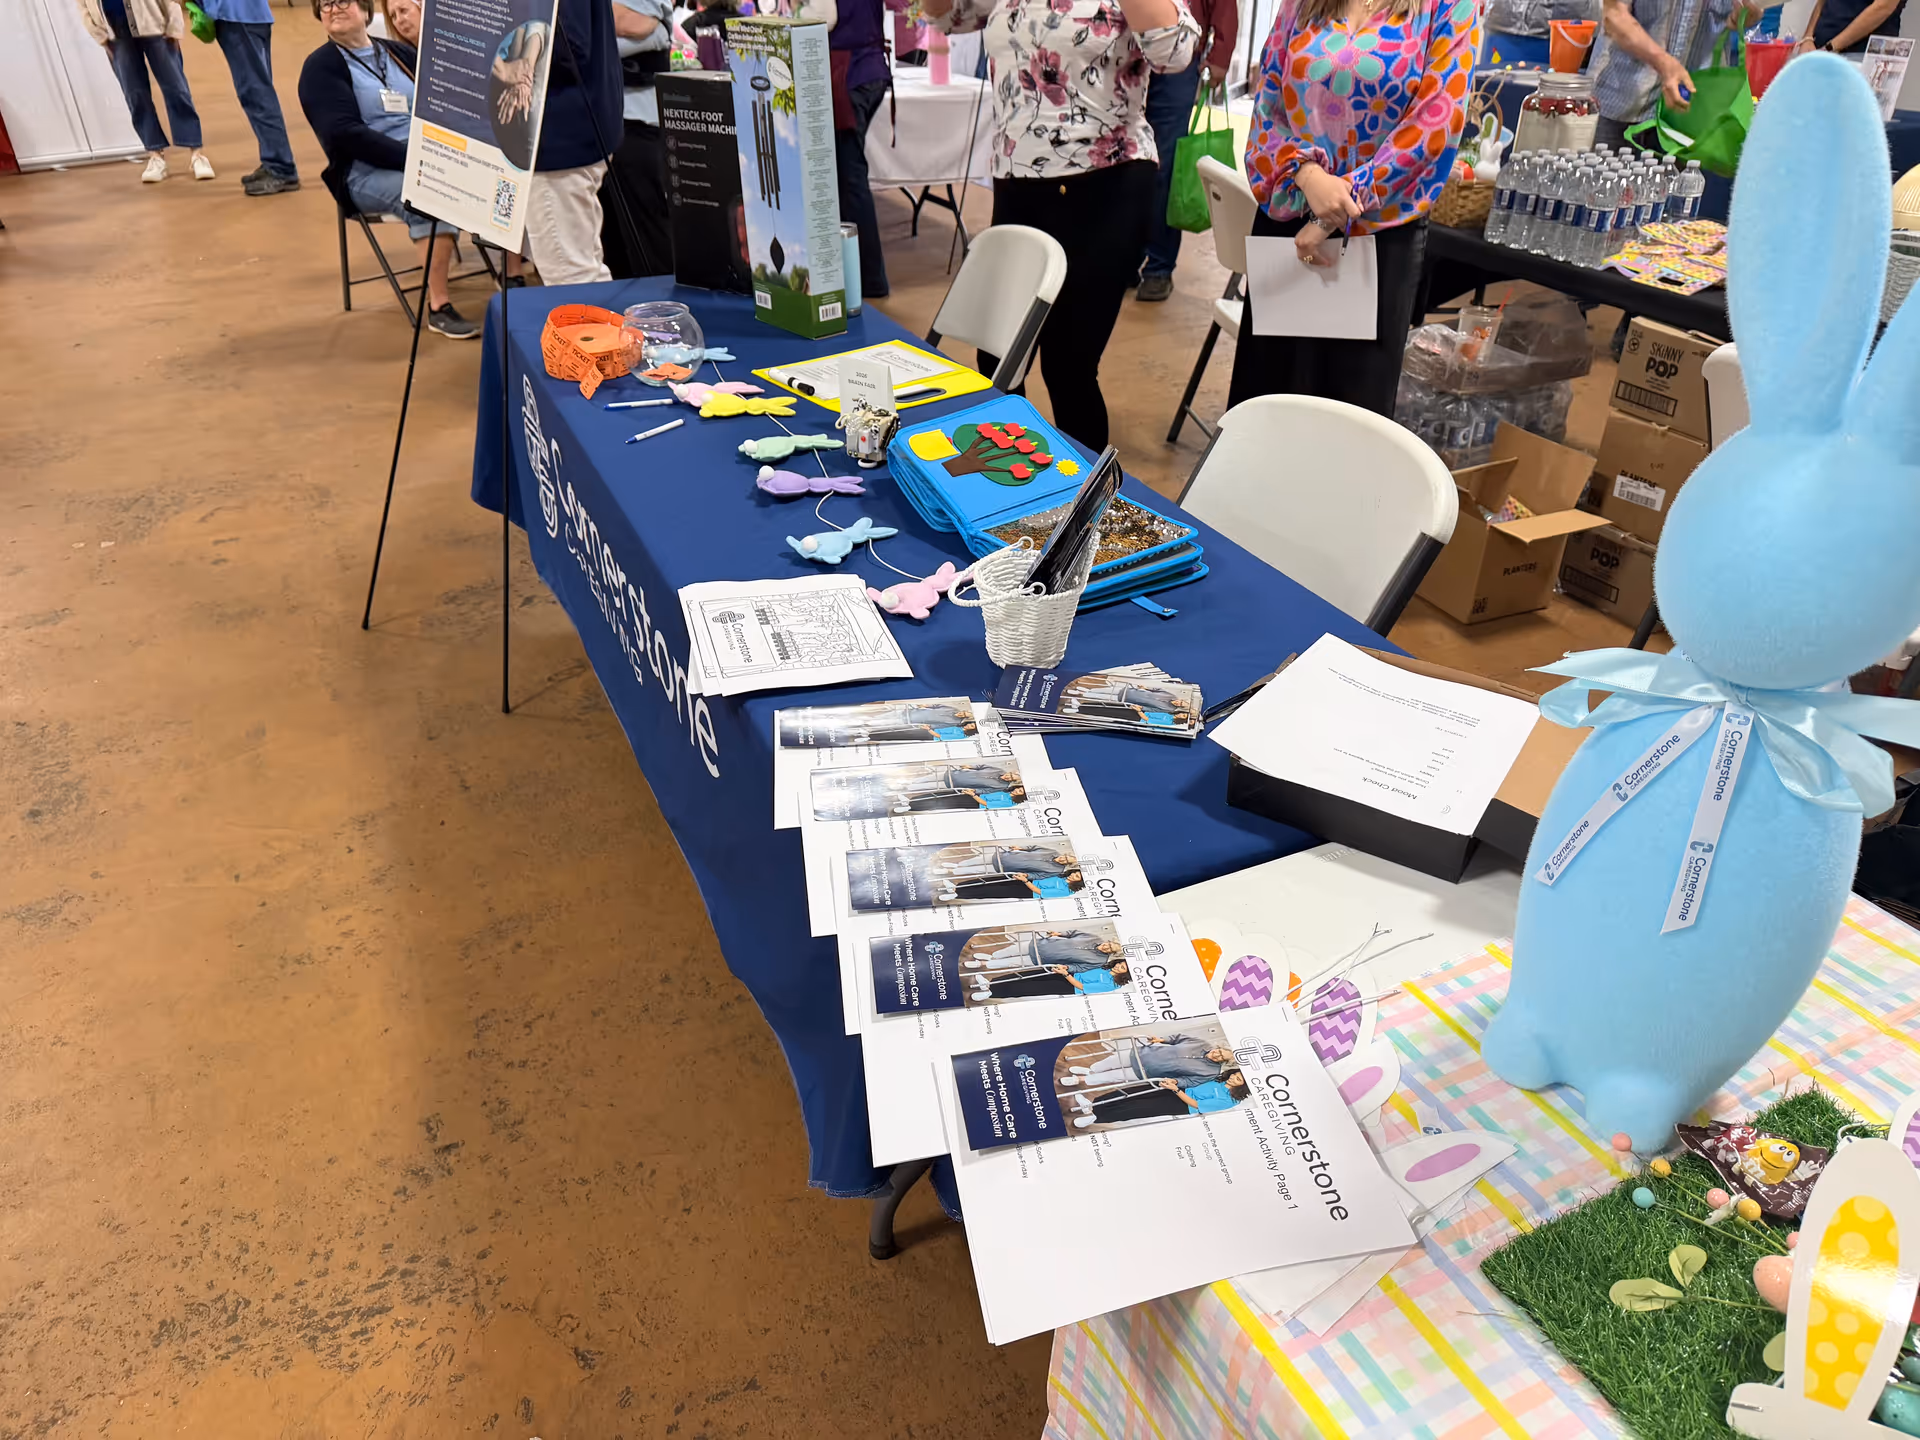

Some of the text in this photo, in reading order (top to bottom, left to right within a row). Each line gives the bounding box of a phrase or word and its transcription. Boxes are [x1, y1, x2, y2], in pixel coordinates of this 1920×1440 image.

[663, 108, 723, 122] NEKTECK FOOT
[664, 120, 707, 132] MASSAGER
[552, 330, 566, 346] TICKET
[572, 349, 590, 364] TICKET
[1646, 357, 1678, 378] POP
[1503, 562, 1536, 576] PLANTERS
[1590, 548, 1620, 570] POP
[551, 438, 720, 779] Cornerstone
[564, 523, 643, 686] CAREGIVING
[722, 625, 735, 651] CAREGIVING
[732, 623, 753, 664] Cornerstone
[1019, 696, 1028, 708] Care
[1040, 682, 1054, 708] Cornerstone
[1624, 734, 1681, 786] Cornerstone
[1713, 730, 1743, 801] Cornerstone
[1715, 729, 1731, 770] CAREGIVING
[1362, 777, 1418, 800] Mood Check
[1630, 762, 1661, 790] CAREGIVING
[1551, 820, 1590, 866] Cornerstone
[1555, 845, 1577, 870] CAREGIVING
[882, 873, 890, 889] Home
[906, 864, 917, 900] Cornerstone
[1678, 857, 1707, 921] Cornerstone
[1680, 856, 1695, 892] CAREGIVING
[884, 890, 892, 906] Care
[893, 944, 908, 1004] Meets Compassion
[905, 938, 920, 1006] Where Home Care
[928, 955, 936, 980] CAREGIVING
[934, 954, 947, 1000] Cornerstone
[978, 1060, 1003, 1137] Meets Compassion
[990, 1052, 1017, 1139] Where Home Care
[1020, 1071, 1032, 1104] CAREGIVING
[1025, 1069, 1047, 1129] Cornerstone
[1250, 1077, 1296, 1156] CAREGIVING
[1090, 1135, 1099, 1148] NOT
[1175, 1146, 1184, 1160] Fruit
[1184, 1144, 1197, 1168] Clothing
[1202, 1142, 1212, 1160] Group
[1265, 1074, 1349, 1221] Cornerstone
[1210, 1138, 1218, 1148] the
[1214, 1148, 1226, 1168] correct
[1221, 1168, 1232, 1184] group
[1256, 1136, 1280, 1172] Activity
[1274, 1173, 1292, 1202] Page
